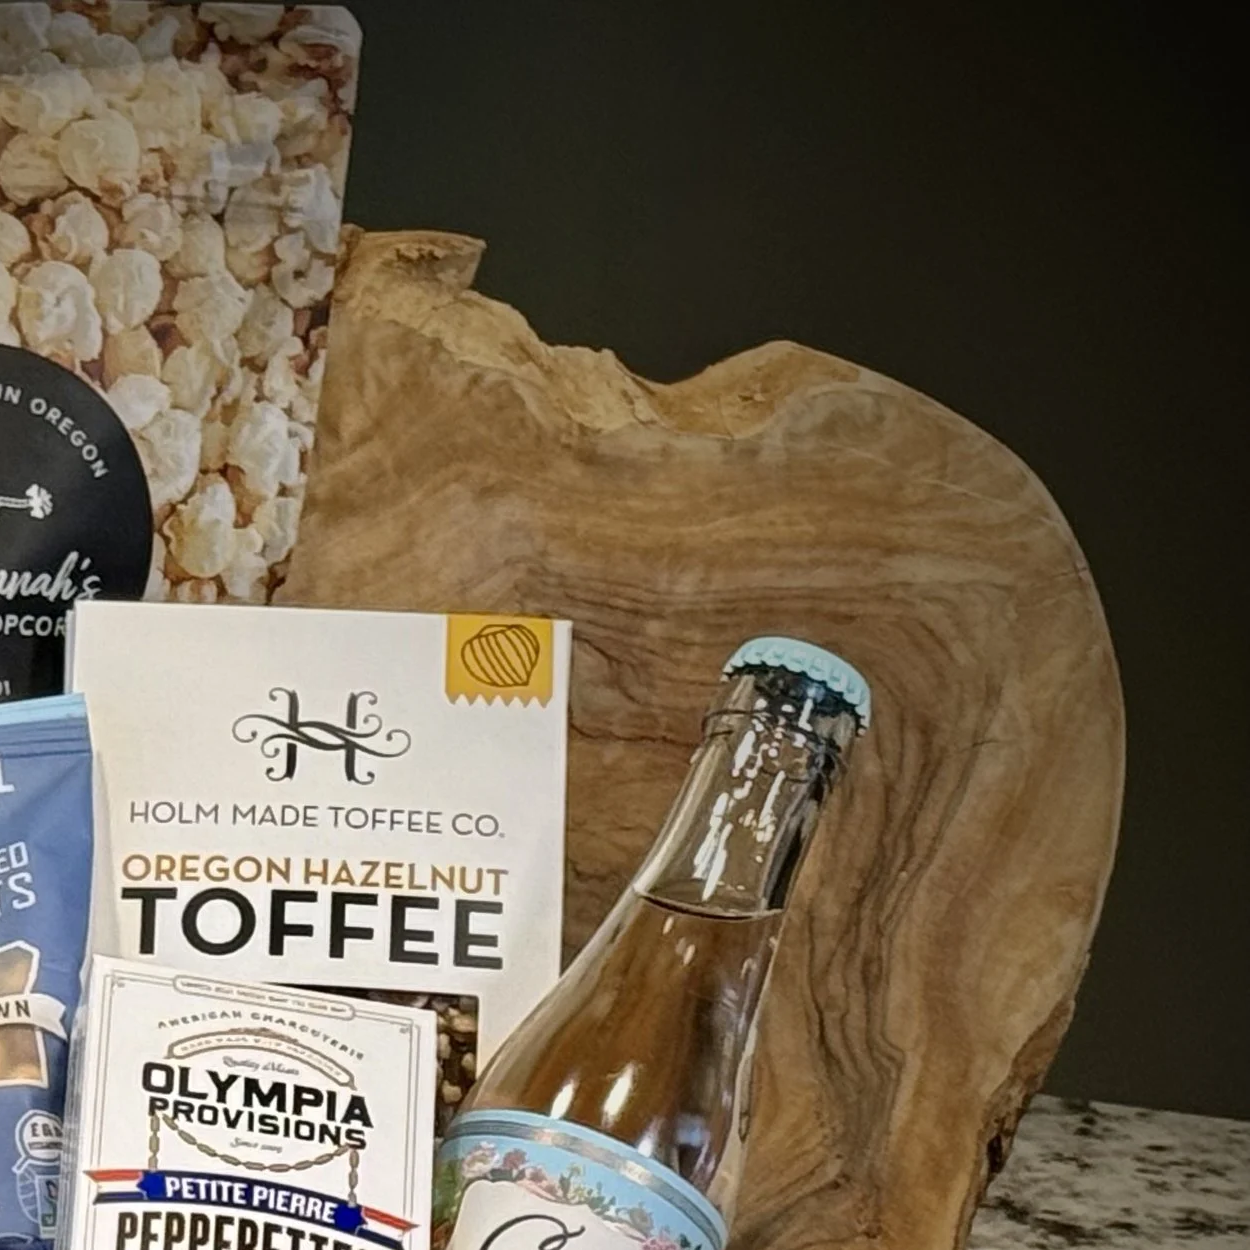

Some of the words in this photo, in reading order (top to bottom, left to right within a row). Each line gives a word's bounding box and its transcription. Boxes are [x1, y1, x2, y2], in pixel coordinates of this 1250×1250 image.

[30, 397, 110, 479] OREGON
[129, 801, 220, 825] HOLM
[232, 804, 320, 829] MADE
[328, 806, 443, 835] TOFFEE
[451, 812, 506, 840] CO.
[121, 853, 293, 886] OREGON
[303, 856, 509, 897] HAZELNUT
[120, 885, 505, 972] TOFFEE
[157, 1010, 243, 1030] AMERICAN
[250, 1011, 366, 1061] CHARCUTERIE
[141, 1061, 375, 1130] OLYMPIA
[148, 1097, 368, 1151] PROVISIONS
[165, 1175, 249, 1205] PETITE
[252, 1186, 339, 1226] PIERRE
